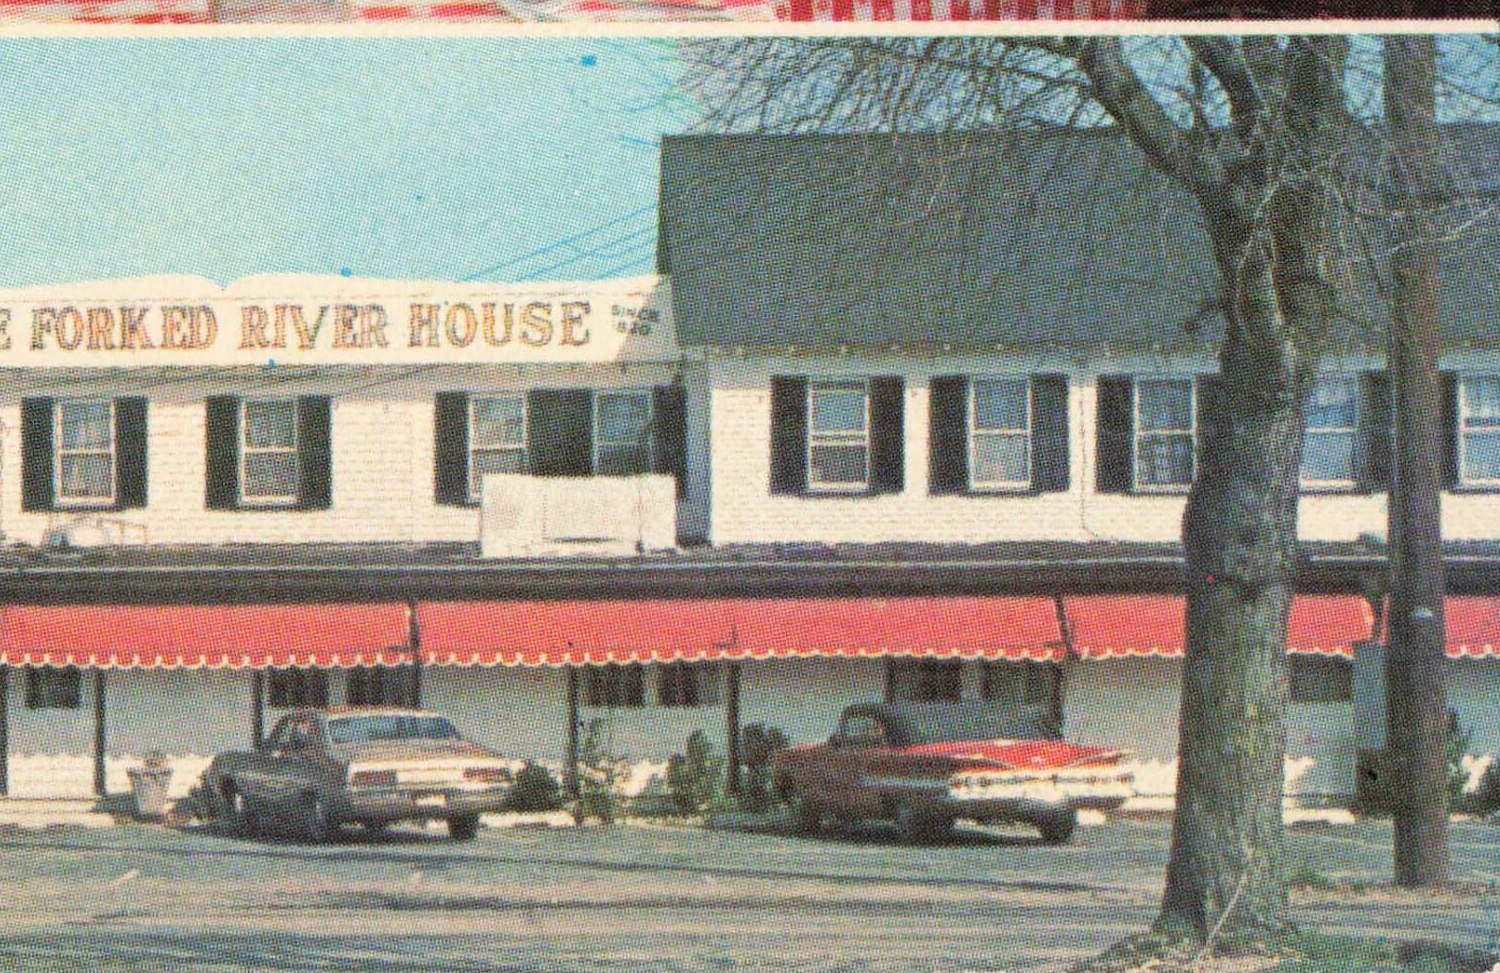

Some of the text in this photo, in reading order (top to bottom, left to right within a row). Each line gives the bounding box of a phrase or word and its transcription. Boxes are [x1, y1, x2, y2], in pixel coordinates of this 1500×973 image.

[30, 305, 218, 352] FORKED
[237, 303, 389, 351] RIVER
[407, 301, 591, 348] HOUSE
